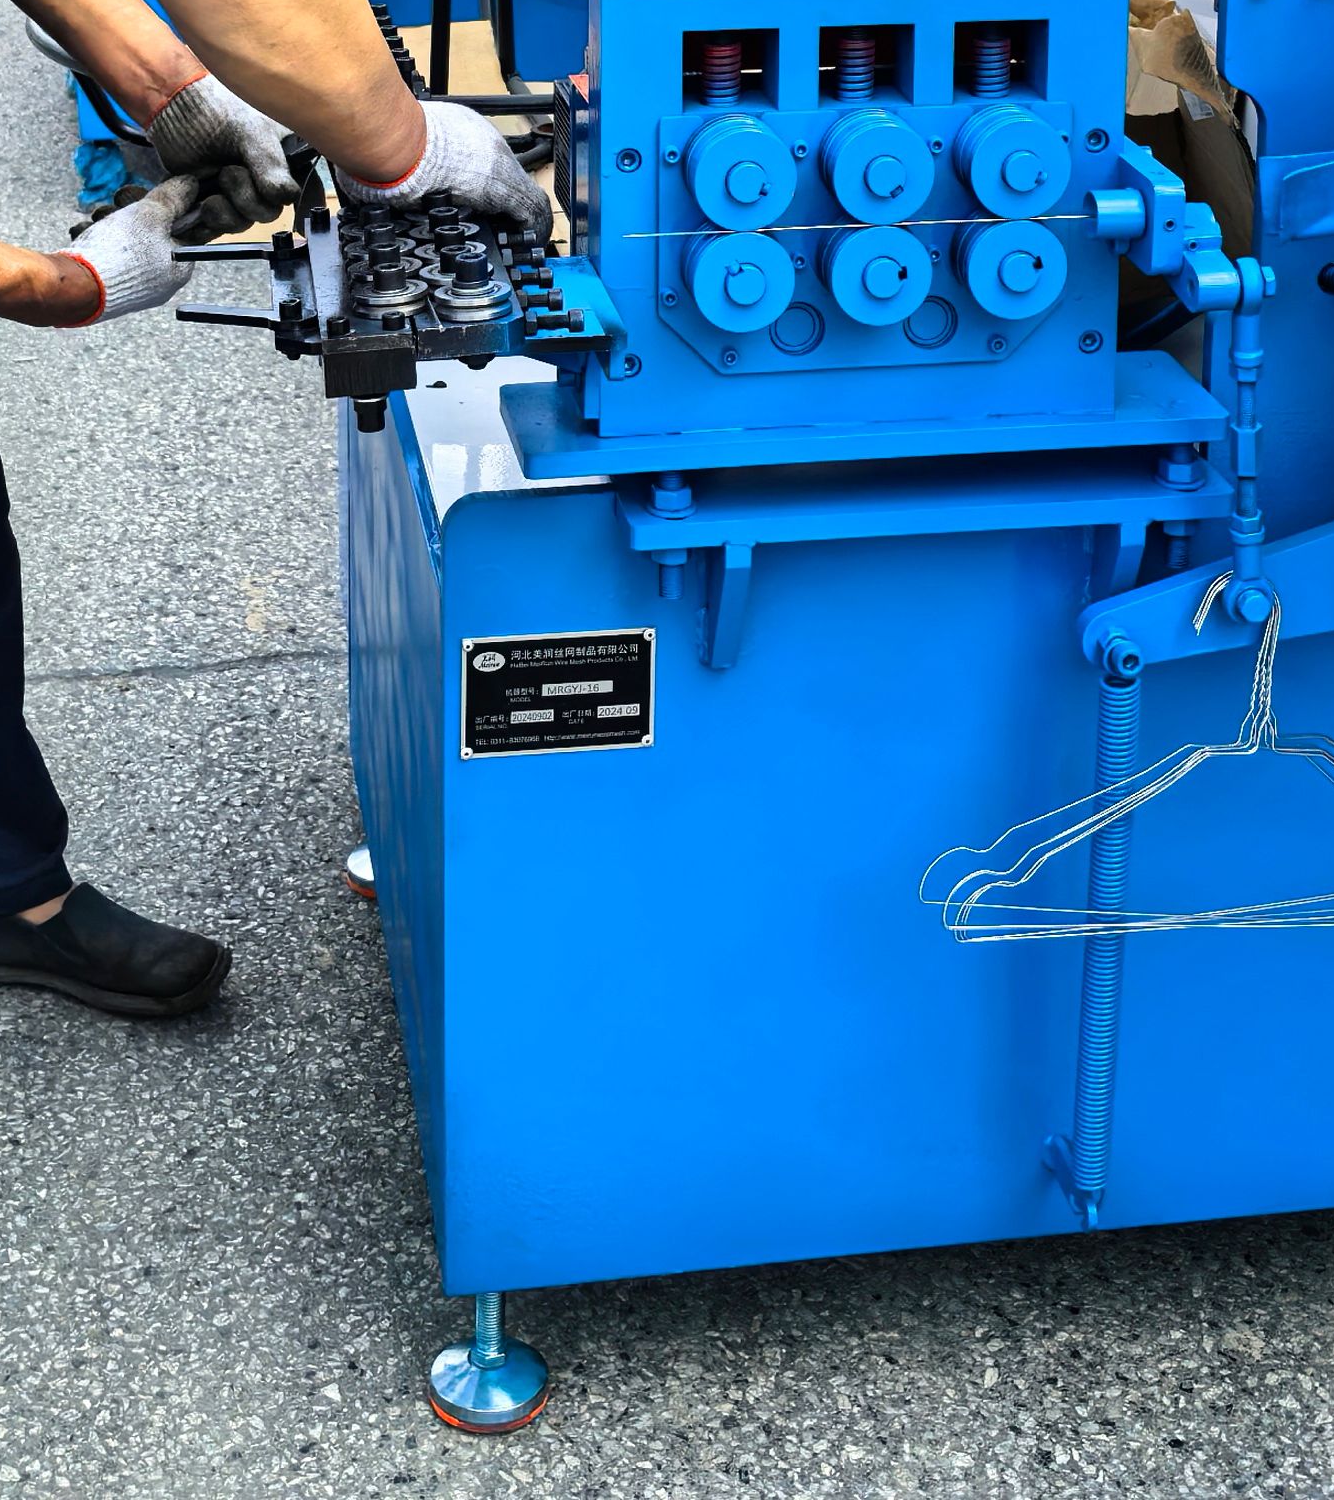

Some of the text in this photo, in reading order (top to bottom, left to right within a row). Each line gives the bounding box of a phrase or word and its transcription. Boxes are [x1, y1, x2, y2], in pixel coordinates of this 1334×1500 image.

[510, 643, 639, 661] 河北美润丝网制品有限公司
[547, 683, 600, 696] MRGYJ-16
